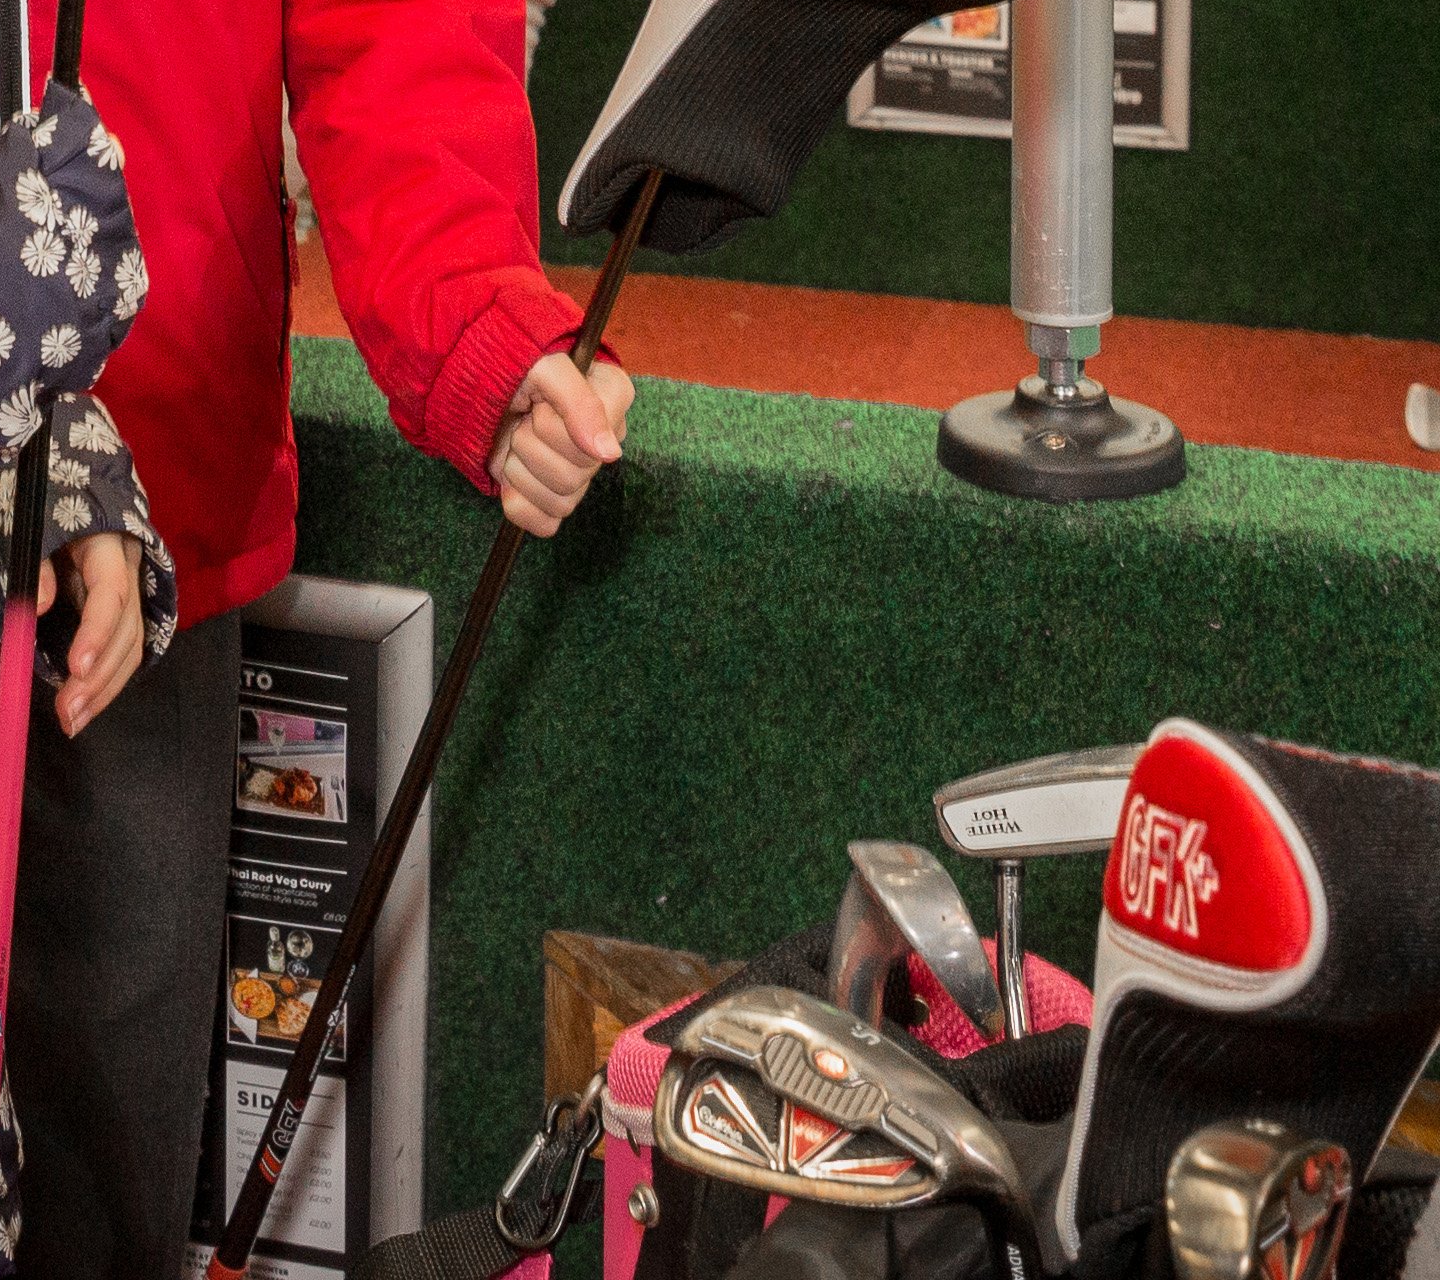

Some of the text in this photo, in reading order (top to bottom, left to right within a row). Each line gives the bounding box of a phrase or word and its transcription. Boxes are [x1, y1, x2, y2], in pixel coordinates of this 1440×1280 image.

[971, 808, 1009, 822] HOT
[965, 821, 1023, 837] WHITE
[251, 871, 274, 883] Red
[275, 874, 298, 889] Veg
[299, 878, 332, 893] Curry
[237, 1090, 274, 1110] SID
